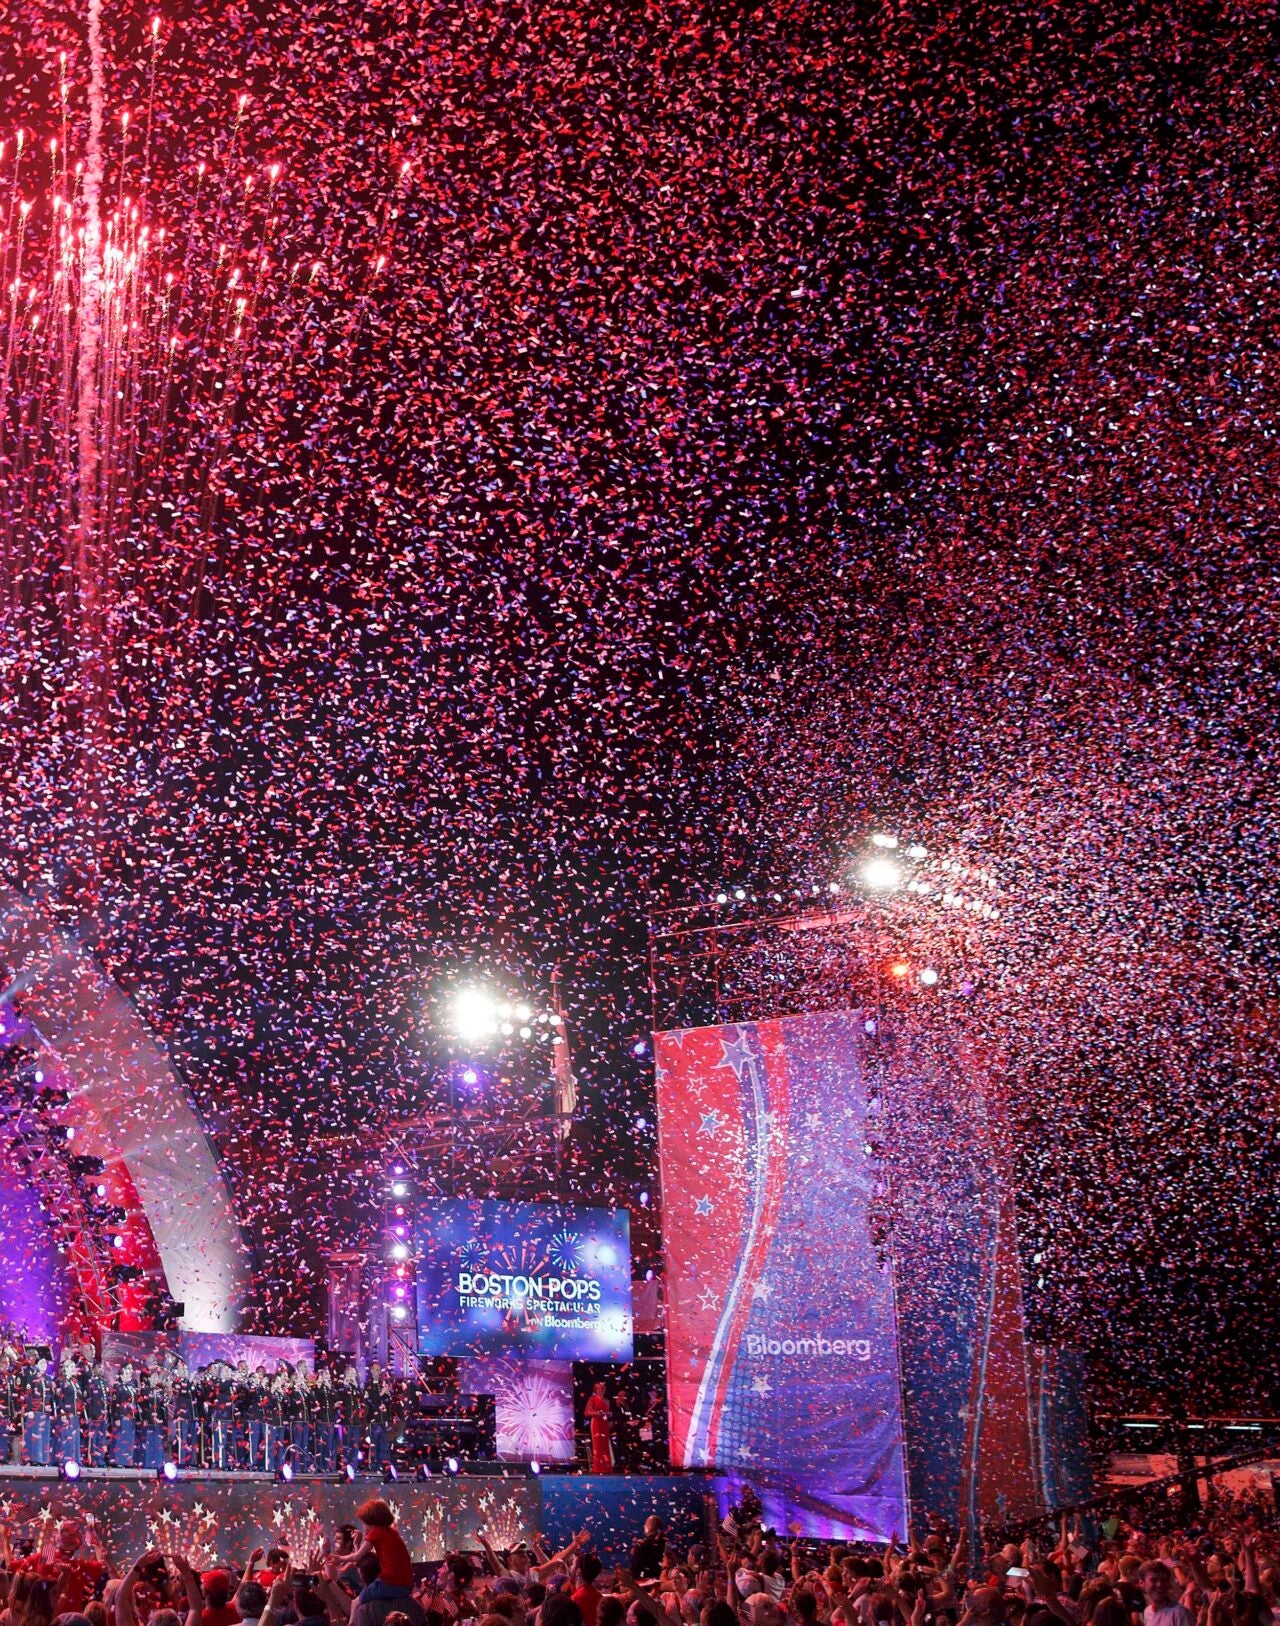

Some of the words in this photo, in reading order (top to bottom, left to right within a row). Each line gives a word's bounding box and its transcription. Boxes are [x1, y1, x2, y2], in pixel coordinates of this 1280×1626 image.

[459, 1272, 542, 1297] BOSTON
[548, 1277, 601, 1300] POPS
[459, 1295, 523, 1310] FIREWORKS
[526, 1299, 601, 1314] SPECTACULAR
[544, 1315, 601, 1333] Bloomberg
[747, 1333, 871, 1361] Bloomberg
